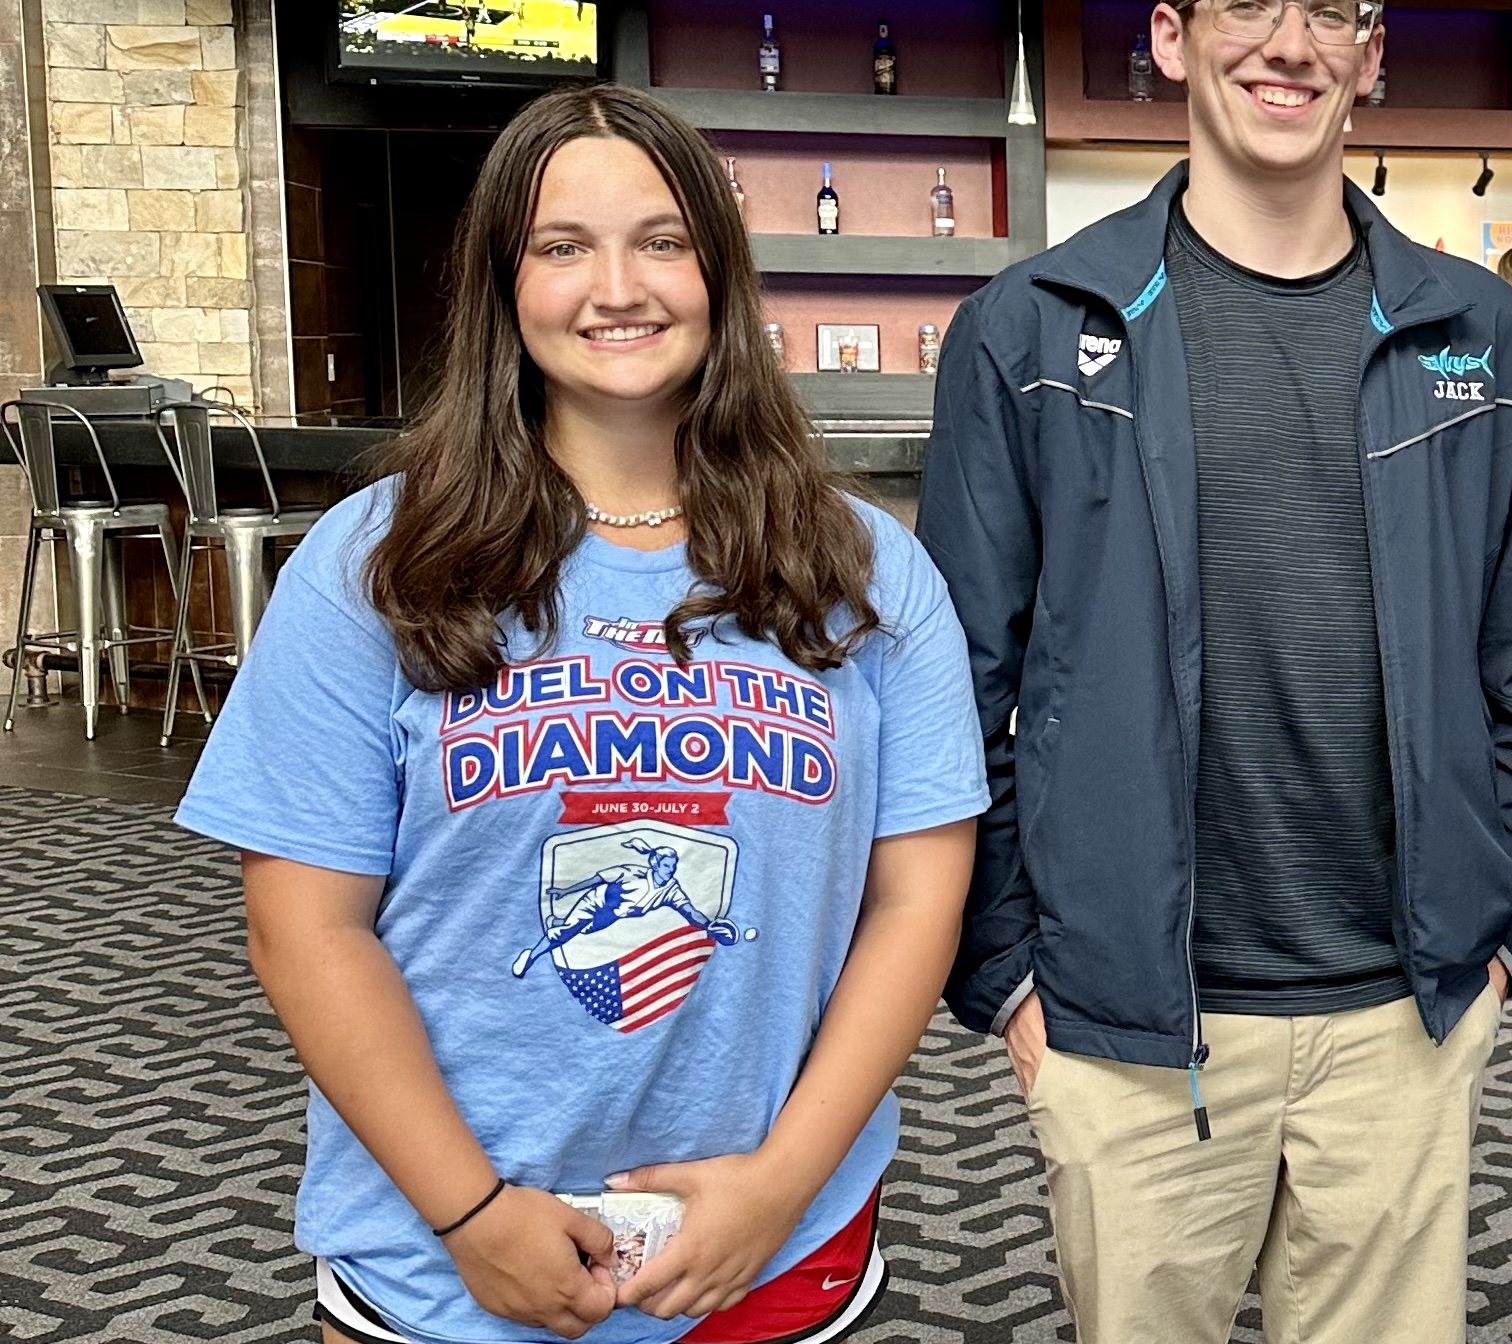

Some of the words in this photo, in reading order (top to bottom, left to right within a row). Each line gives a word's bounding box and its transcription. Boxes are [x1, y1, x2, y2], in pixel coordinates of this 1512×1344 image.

[1434, 381, 1485, 401] JACK
[446, 659, 606, 731] DUEL
[616, 660, 713, 706] ON
[721, 665, 834, 733] THE
[447, 715, 837, 803] DIAMOND
[591, 803, 628, 814] JUNE
[631, 803, 688, 814] 30-JULY
[690, 803, 700, 814] 2
